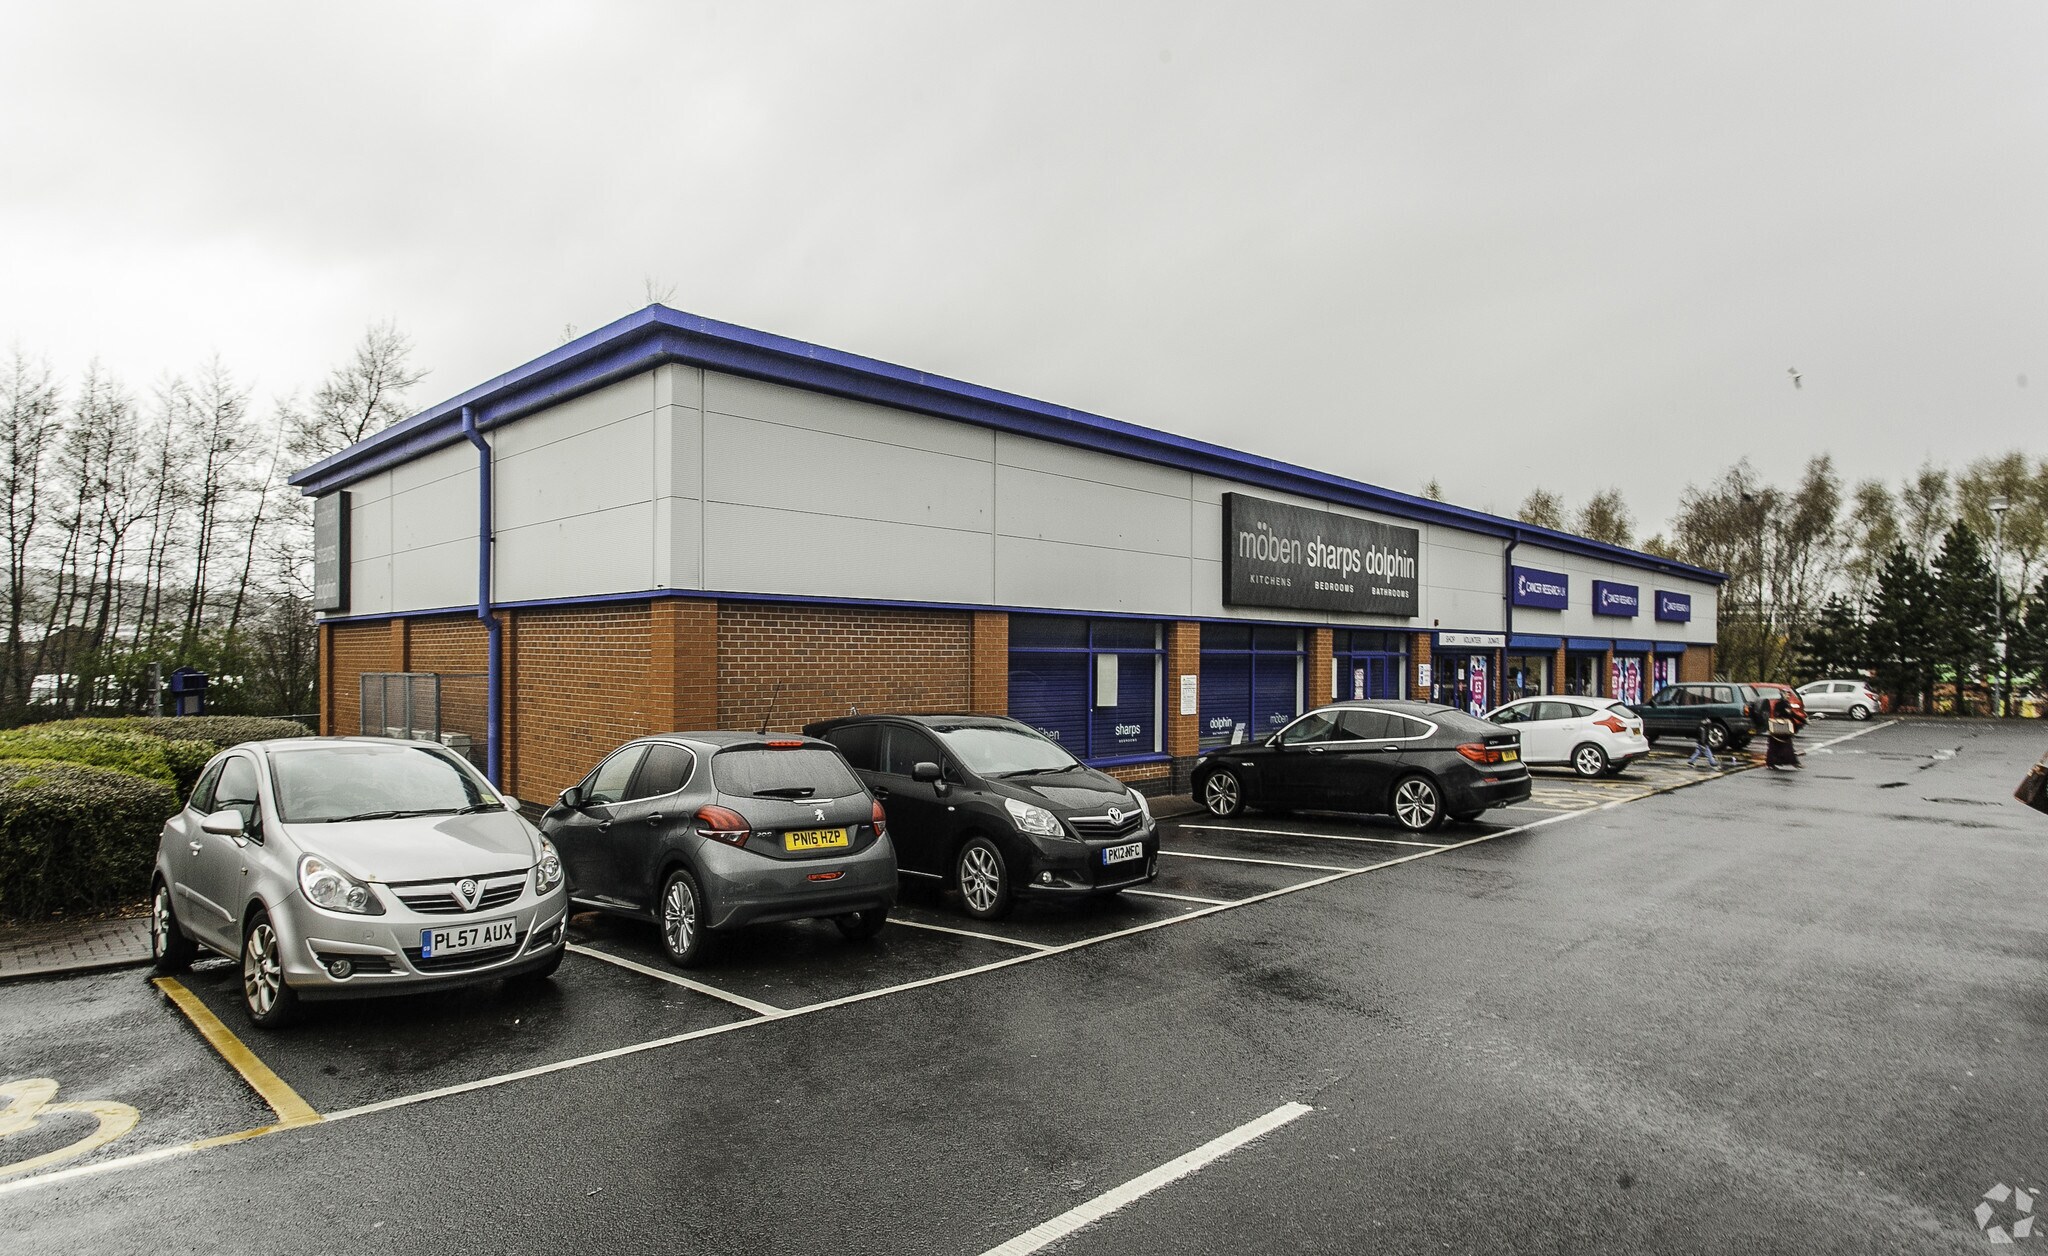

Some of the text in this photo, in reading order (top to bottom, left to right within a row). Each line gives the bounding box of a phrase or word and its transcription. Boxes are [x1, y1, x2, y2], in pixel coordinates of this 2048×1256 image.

[1239, 521, 1415, 584] möben sharps dolphin
[1250, 574, 1410, 599] KITCHENS BEDROOMS BATHROOMS
[1115, 723, 1141, 737] sharps
[1210, 716, 1232, 730] dolphin
[792, 830, 841, 846] PN16 HZP
[1108, 847, 1125, 861] PK12
[434, 923, 513, 951] PL57 AUX
